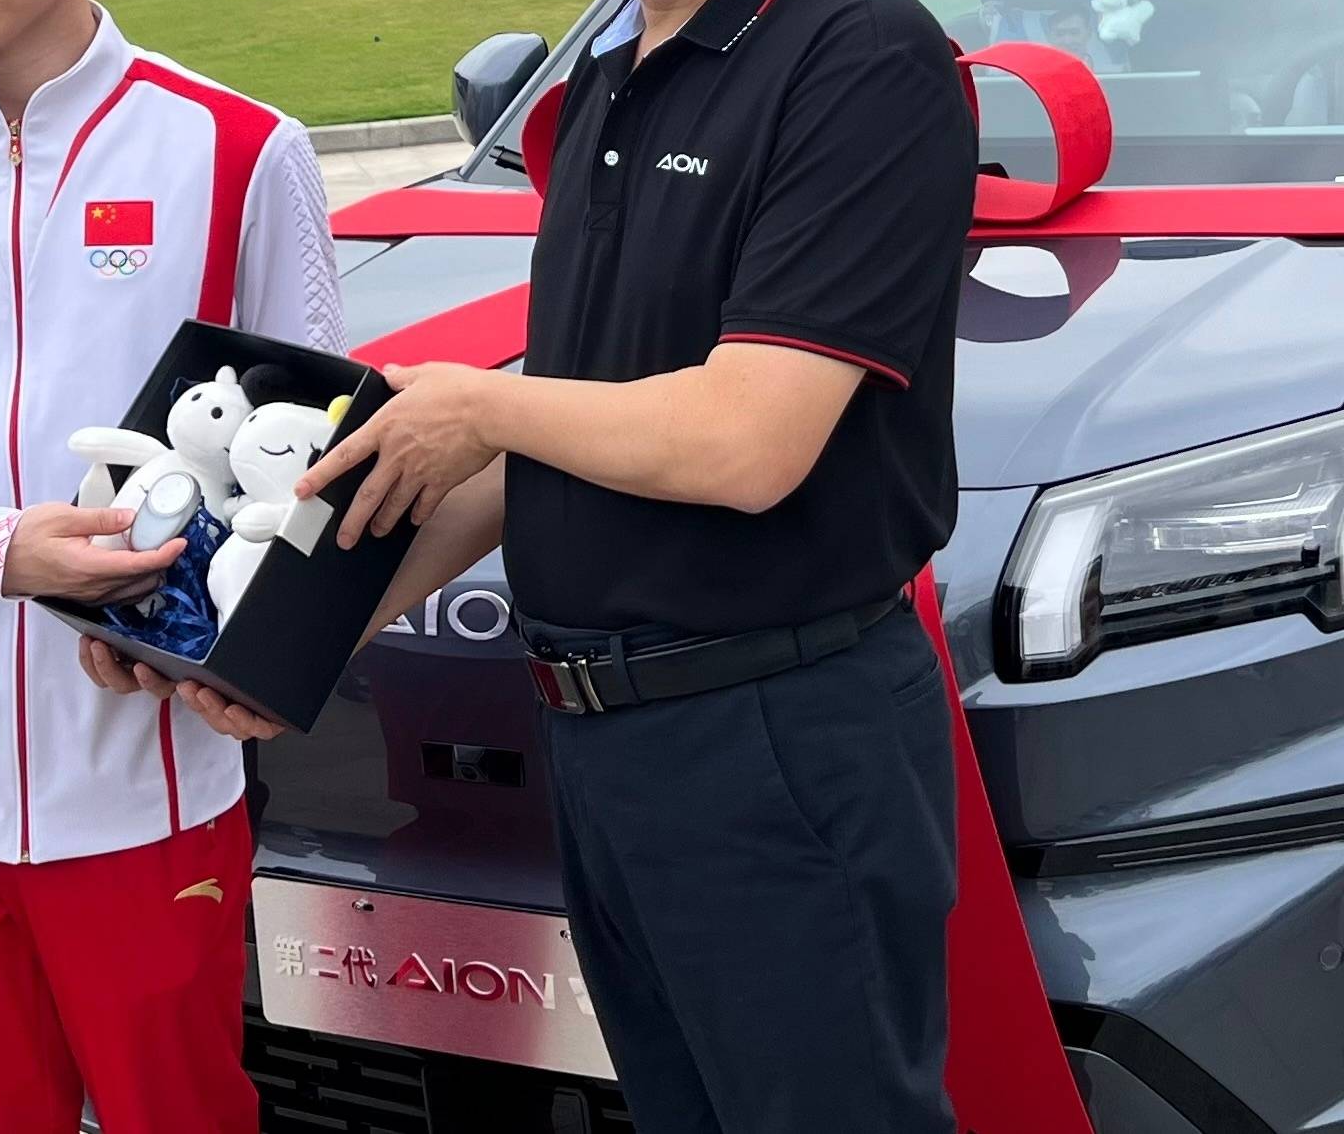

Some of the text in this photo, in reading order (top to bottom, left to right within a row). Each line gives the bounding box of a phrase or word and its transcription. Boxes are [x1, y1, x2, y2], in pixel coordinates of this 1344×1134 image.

[272, 934, 378, 988] 第二代
[385, 951, 556, 1010] AION
